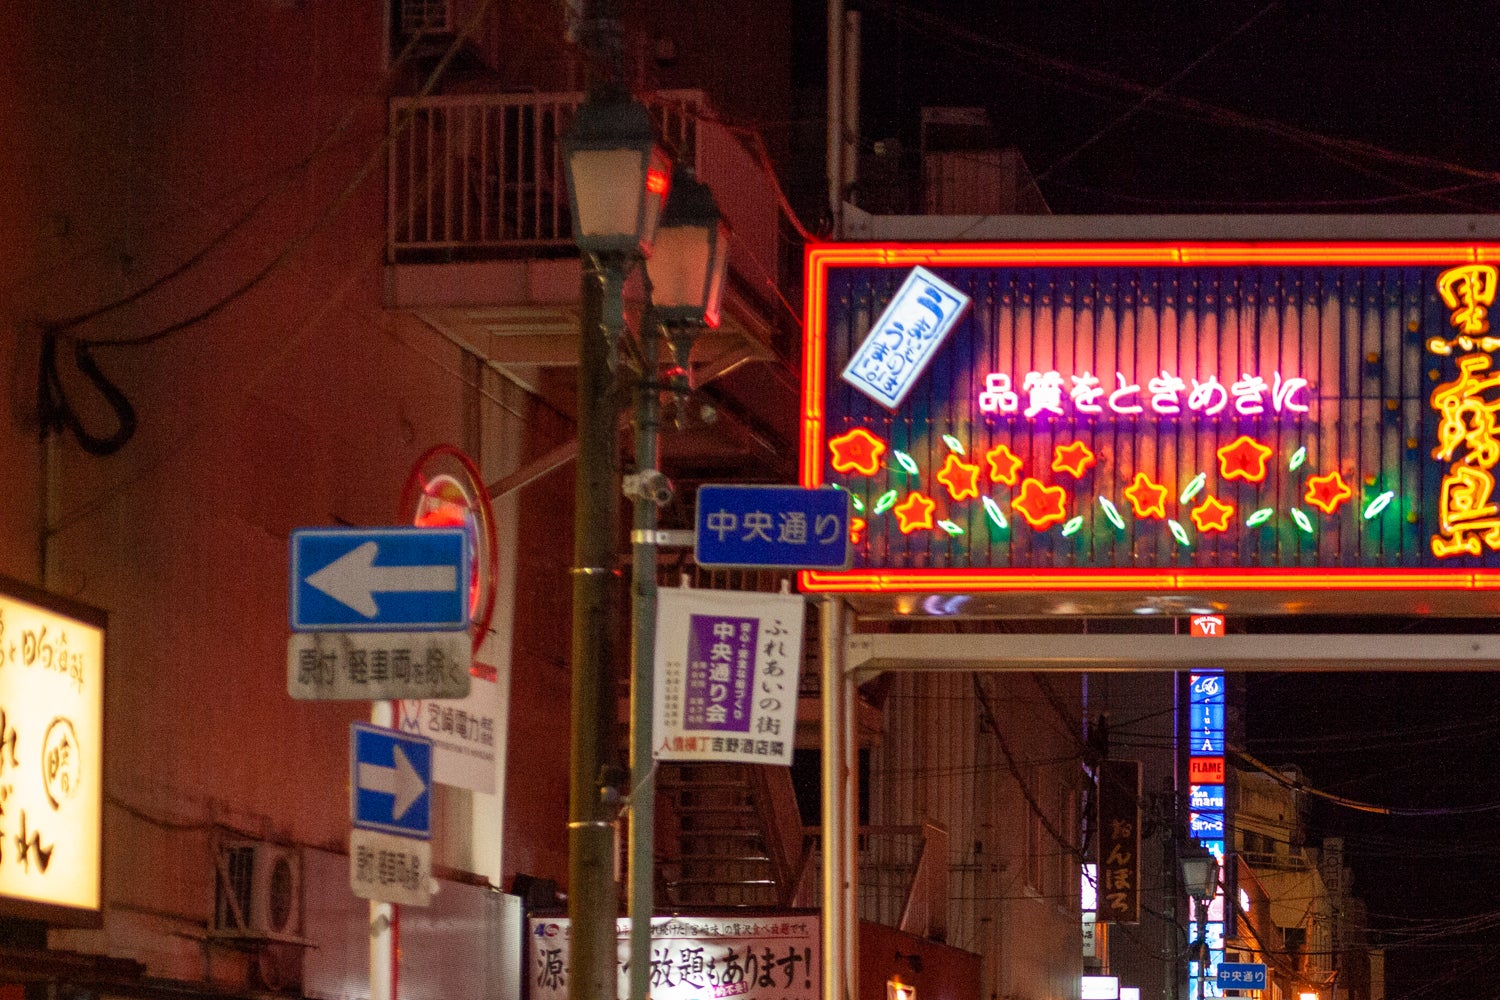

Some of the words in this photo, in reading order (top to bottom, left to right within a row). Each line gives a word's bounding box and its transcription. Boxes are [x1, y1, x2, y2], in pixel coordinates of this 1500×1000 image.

[979, 370, 1310, 418] 品質をときめきに
[706, 508, 841, 545] 中央通り
[705, 621, 735, 724] 中央通り会
[756, 619, 789, 736] ふれあいの街
[1192, 762, 1222, 773] FLAME
[1191, 797, 1224, 807] maru
[1219, 969, 1265, 983] 中央通り
